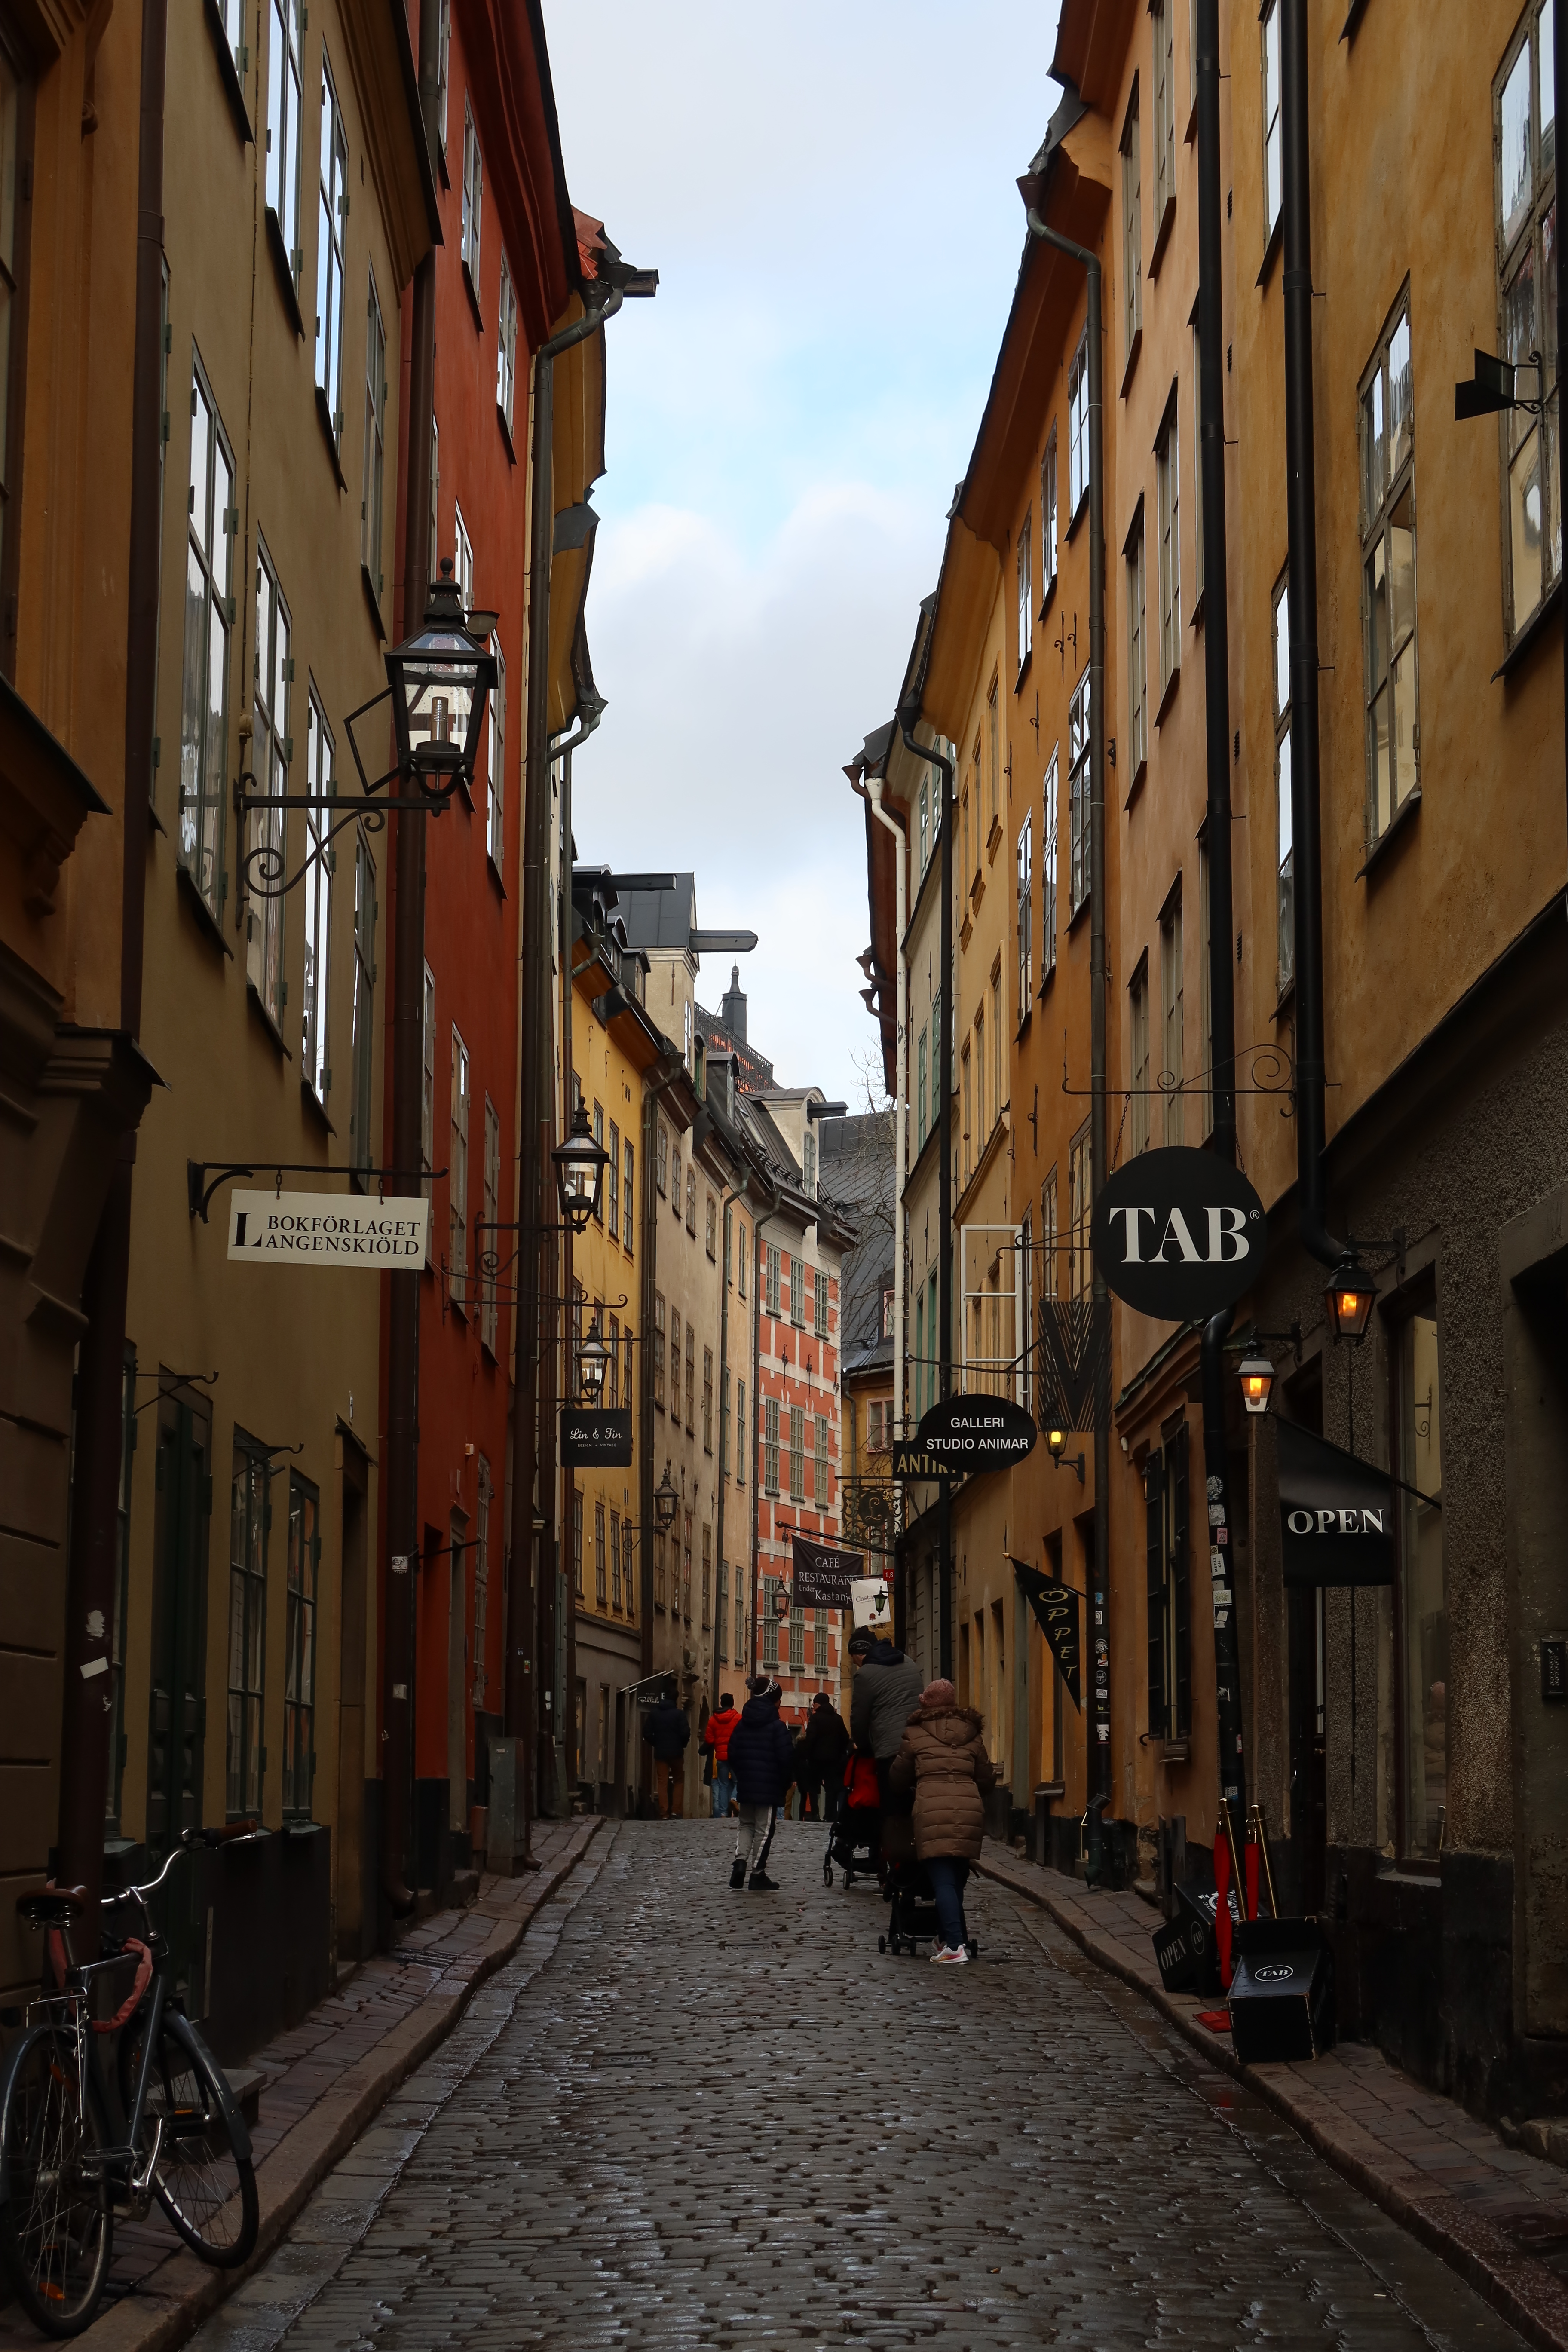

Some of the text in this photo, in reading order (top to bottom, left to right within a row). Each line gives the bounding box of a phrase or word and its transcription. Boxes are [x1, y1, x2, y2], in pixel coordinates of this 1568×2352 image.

[267, 1215, 420, 1237] BOKFÖRLAGET
[950, 1417, 1004, 1428] GALLERI
[570, 1427, 622, 1439] Lin & Fin
[926, 1438, 1029, 1450] STUDIO ANIMAR
[897, 1454, 956, 1474] ANTIK
[1288, 1509, 1384, 1534] OPEN
[815, 1555, 840, 1568] CAFÉ
[1039, 1588, 1078, 1679] ÖPPET
[1193, 1930, 1203, 1945] TAB
[1161, 1935, 1186, 1970] OPEN
